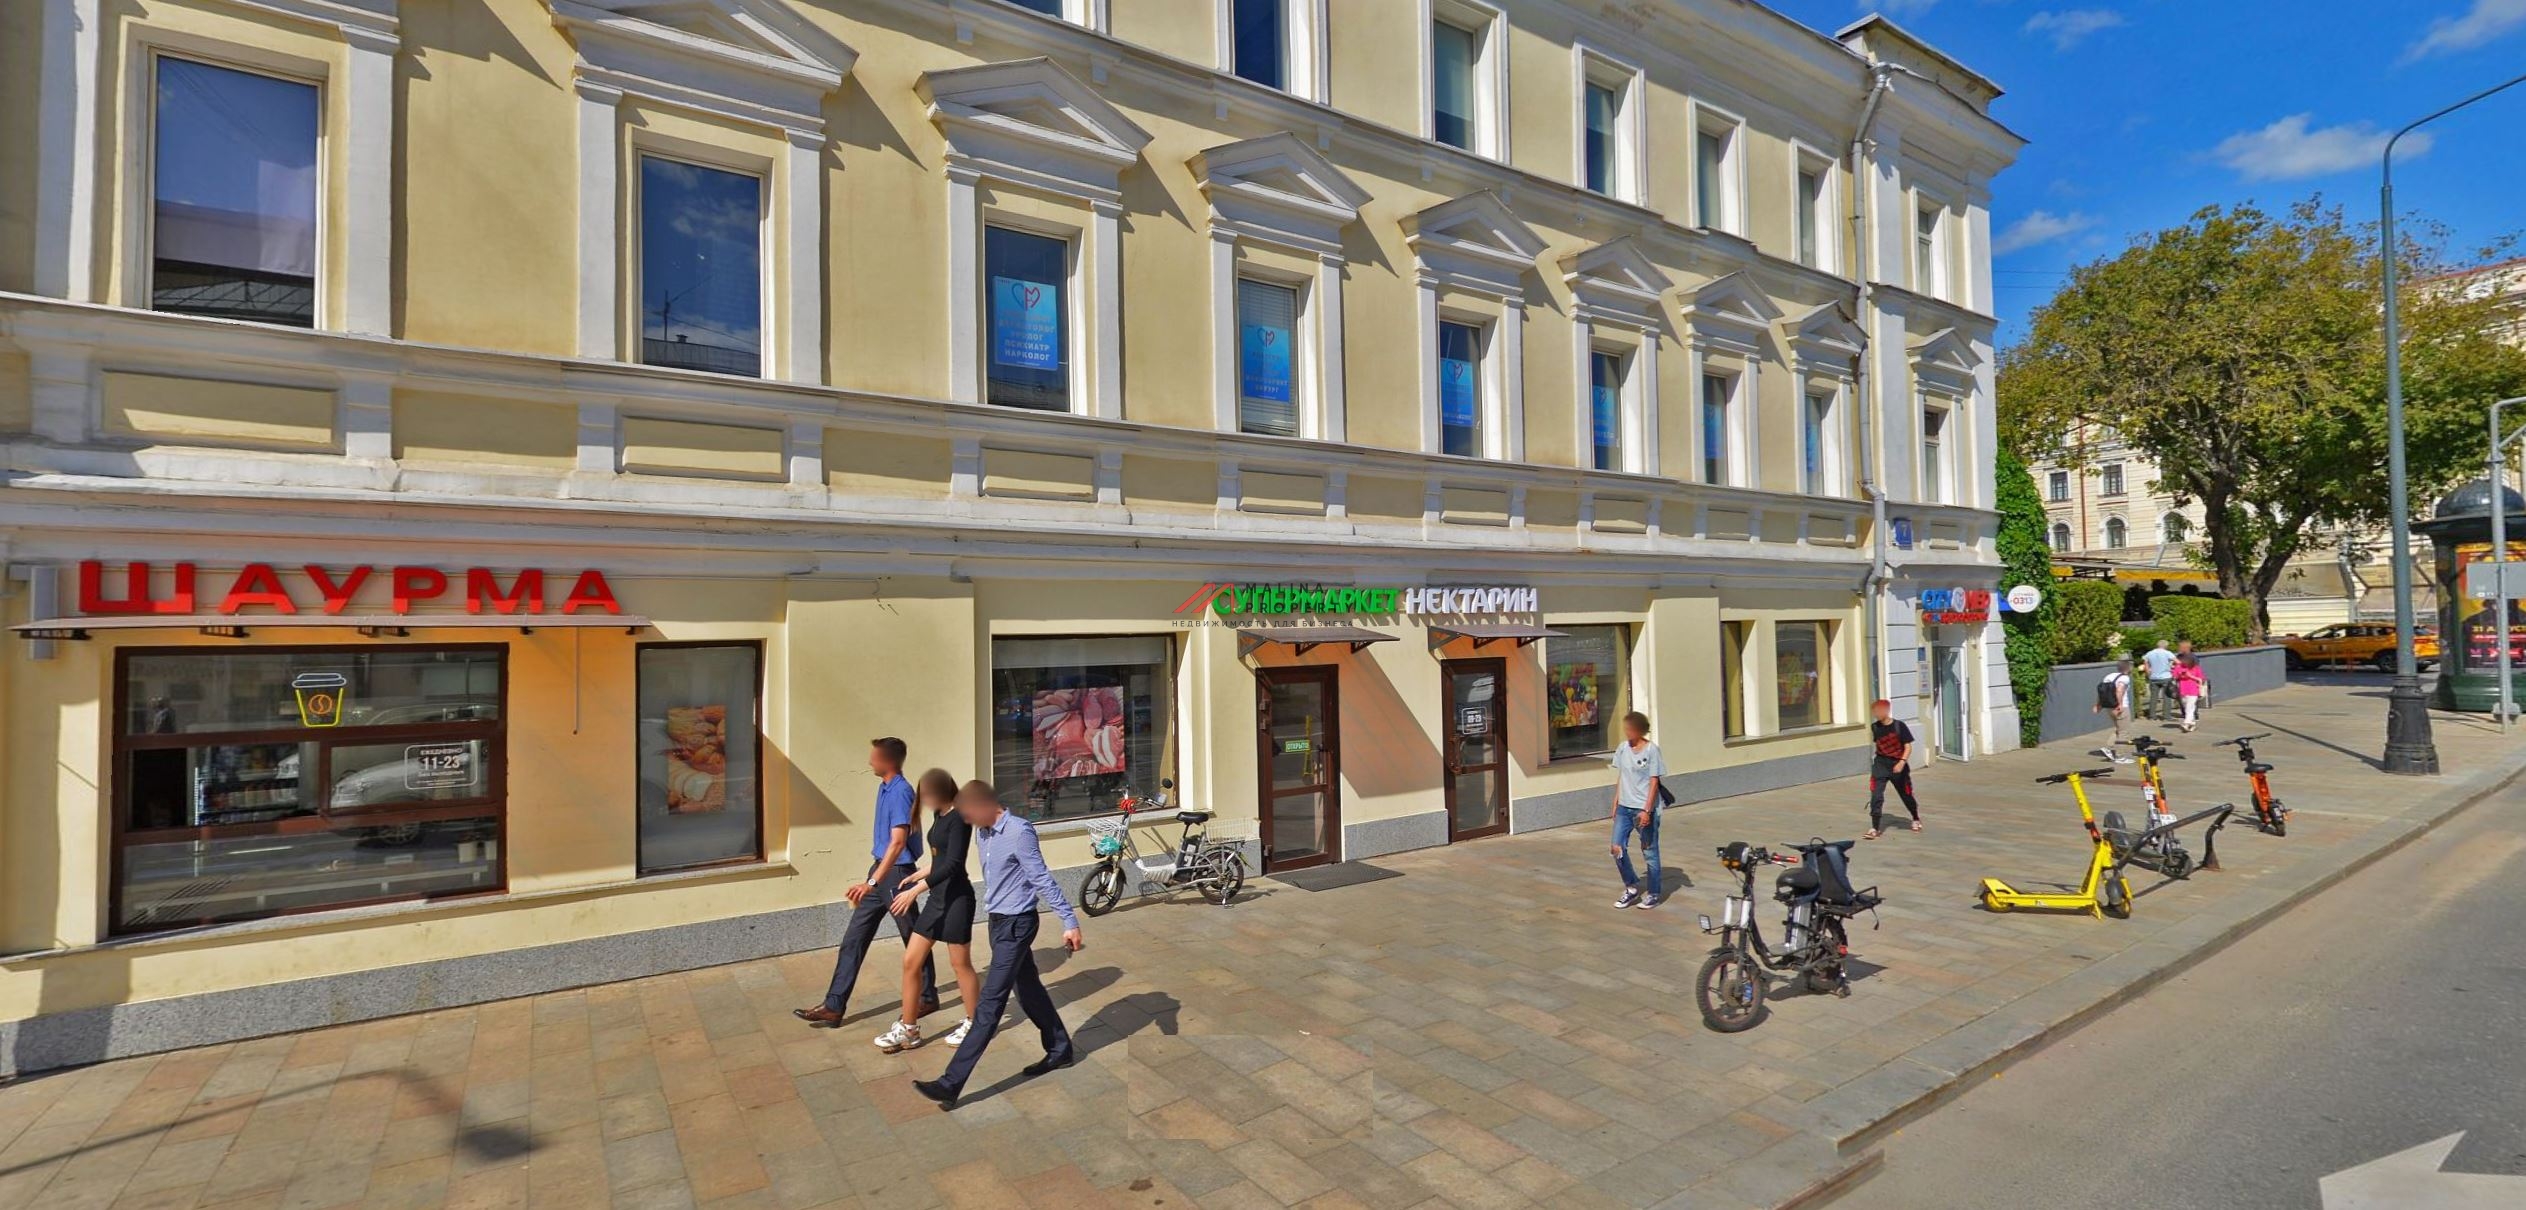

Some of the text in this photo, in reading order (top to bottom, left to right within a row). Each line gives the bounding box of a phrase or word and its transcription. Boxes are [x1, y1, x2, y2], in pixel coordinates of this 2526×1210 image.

[1004, 348, 1051, 361] НАРКОЛОГ
[79, 560, 622, 615] ШАУРМА
[1212, 587, 1400, 614] СУПЕРМАРКЕТ
[1405, 587, 1538, 614] НЕКТАРИН
[422, 756, 460, 771] 11-23
